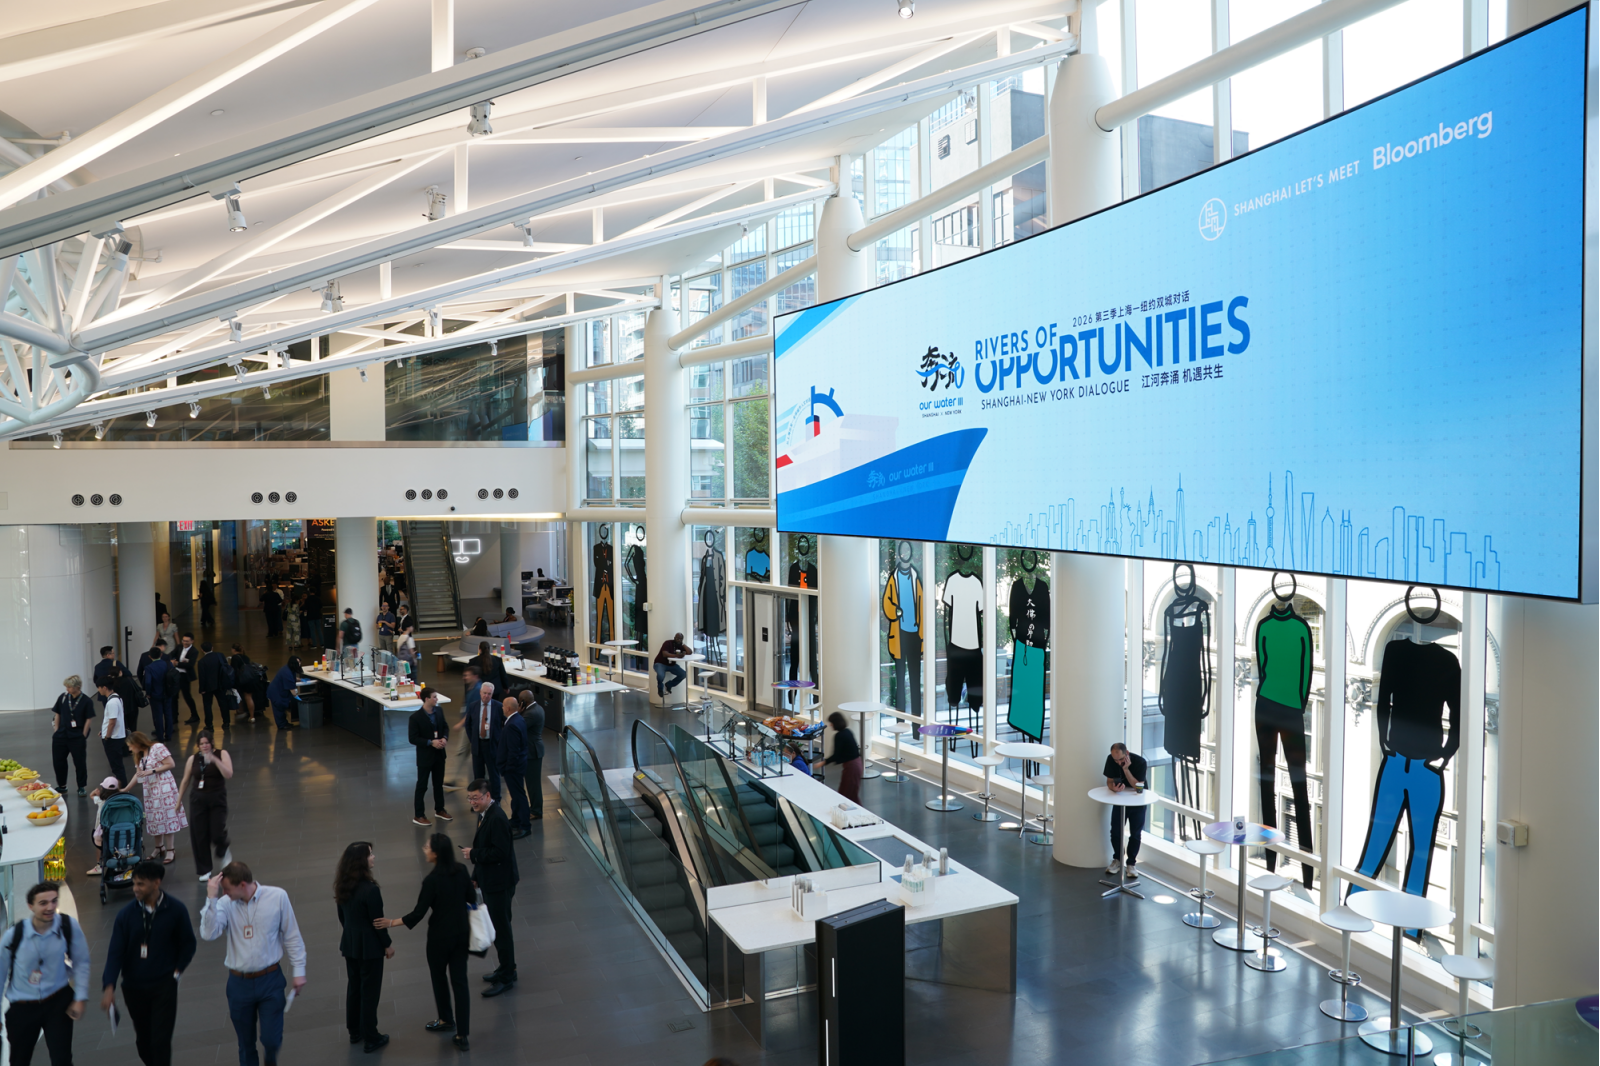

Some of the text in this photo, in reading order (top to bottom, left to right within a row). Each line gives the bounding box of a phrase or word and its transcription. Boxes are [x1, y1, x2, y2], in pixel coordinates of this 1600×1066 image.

[1373, 110, 1493, 170] Bloomberg
[1234, 160, 1360, 216] SHANGHAI LET'S MEET
[1072, 313, 1093, 328] 2026
[974, 295, 1251, 394] OPPORTUNITIES
[975, 322, 1057, 361] RIVERS OF
[1141, 363, 1224, 389] 江河奔涌 机遇共生
[919, 401, 932, 411] our
[933, 396, 957, 409] water
[981, 379, 1130, 410] SHANGHAI-NEW YORK DIALOGUE
[888, 470, 902, 482] our
[903, 463, 927, 478] water
[179, 520, 193, 531] EXIT
